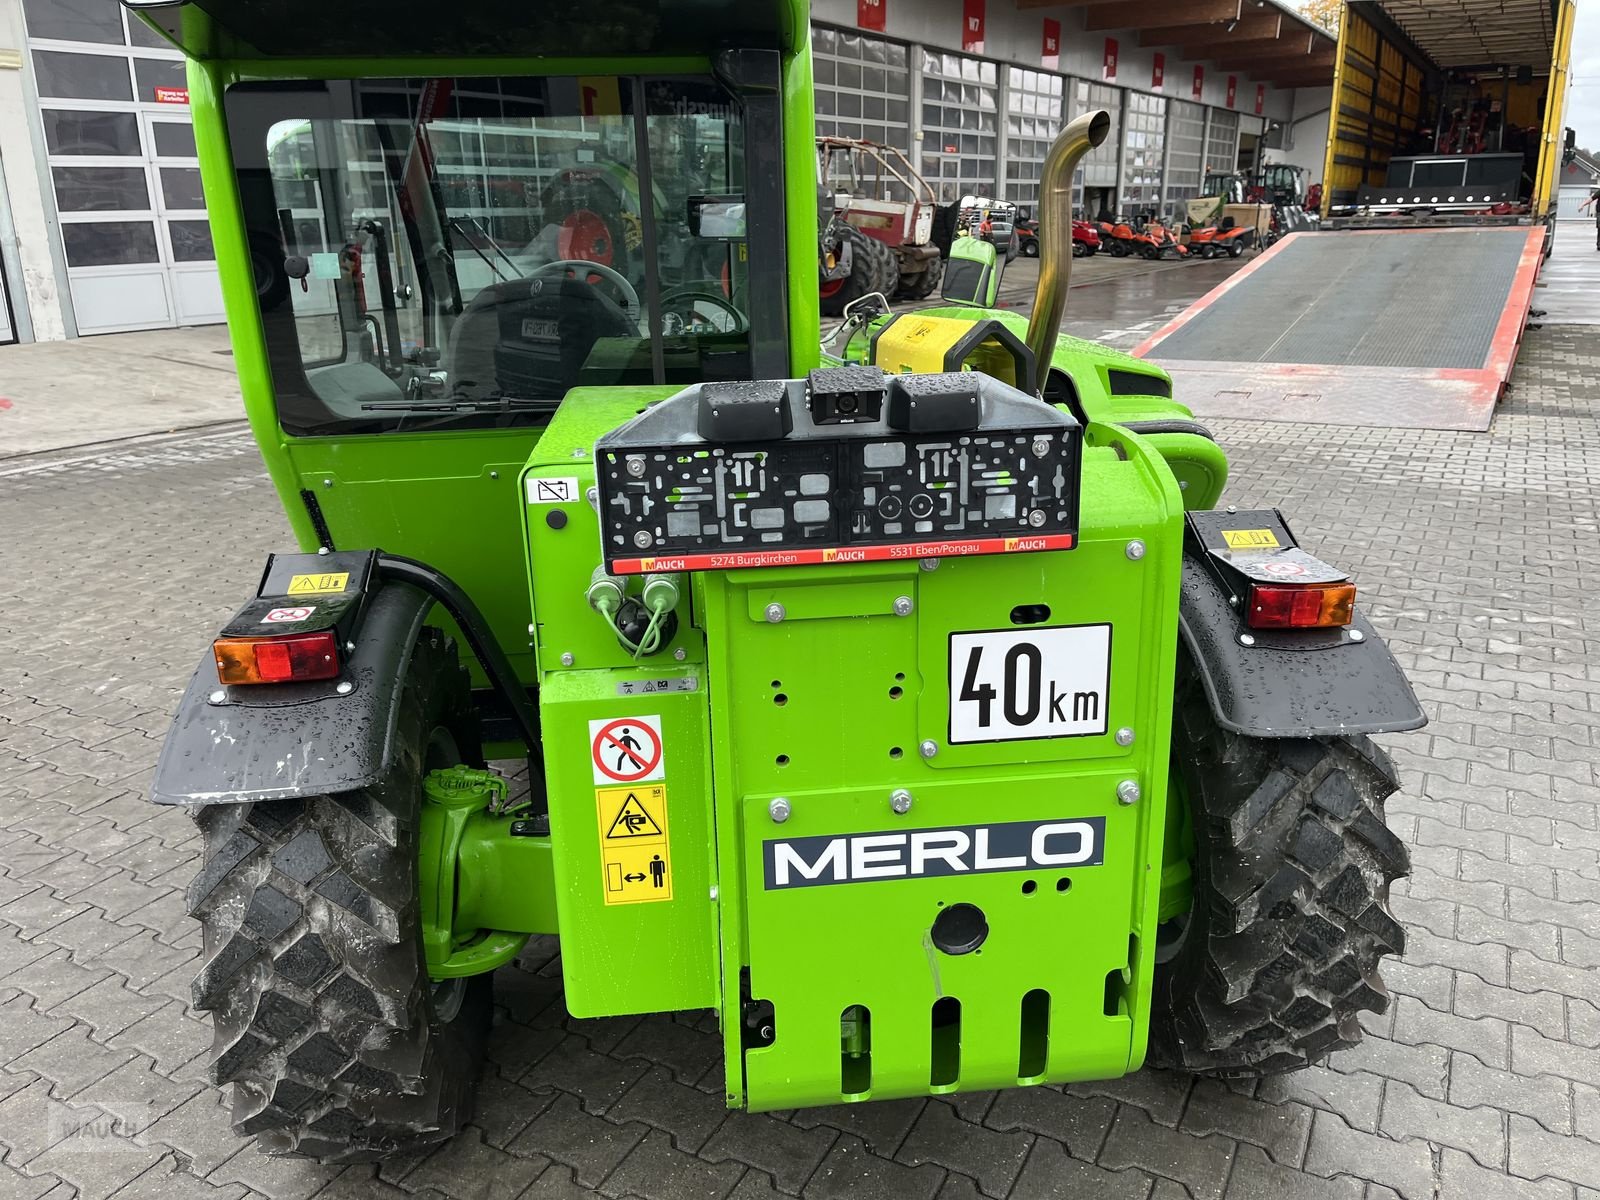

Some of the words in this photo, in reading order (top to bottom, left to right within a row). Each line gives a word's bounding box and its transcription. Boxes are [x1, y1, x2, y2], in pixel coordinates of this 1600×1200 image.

[645, 559, 685, 571] MAUCH
[711, 556, 735, 567] 5274
[738, 553, 797, 567] Burgkirchen
[827, 550, 865, 561] MAUCH
[890, 545, 912, 556] 5531
[916, 543, 980, 556] Eben/Pongau
[1009, 540, 1047, 551] MAUCH
[959, 642, 1042, 727] 40
[1049, 681, 1098, 722] km
[774, 822, 1094, 885] MERLO
